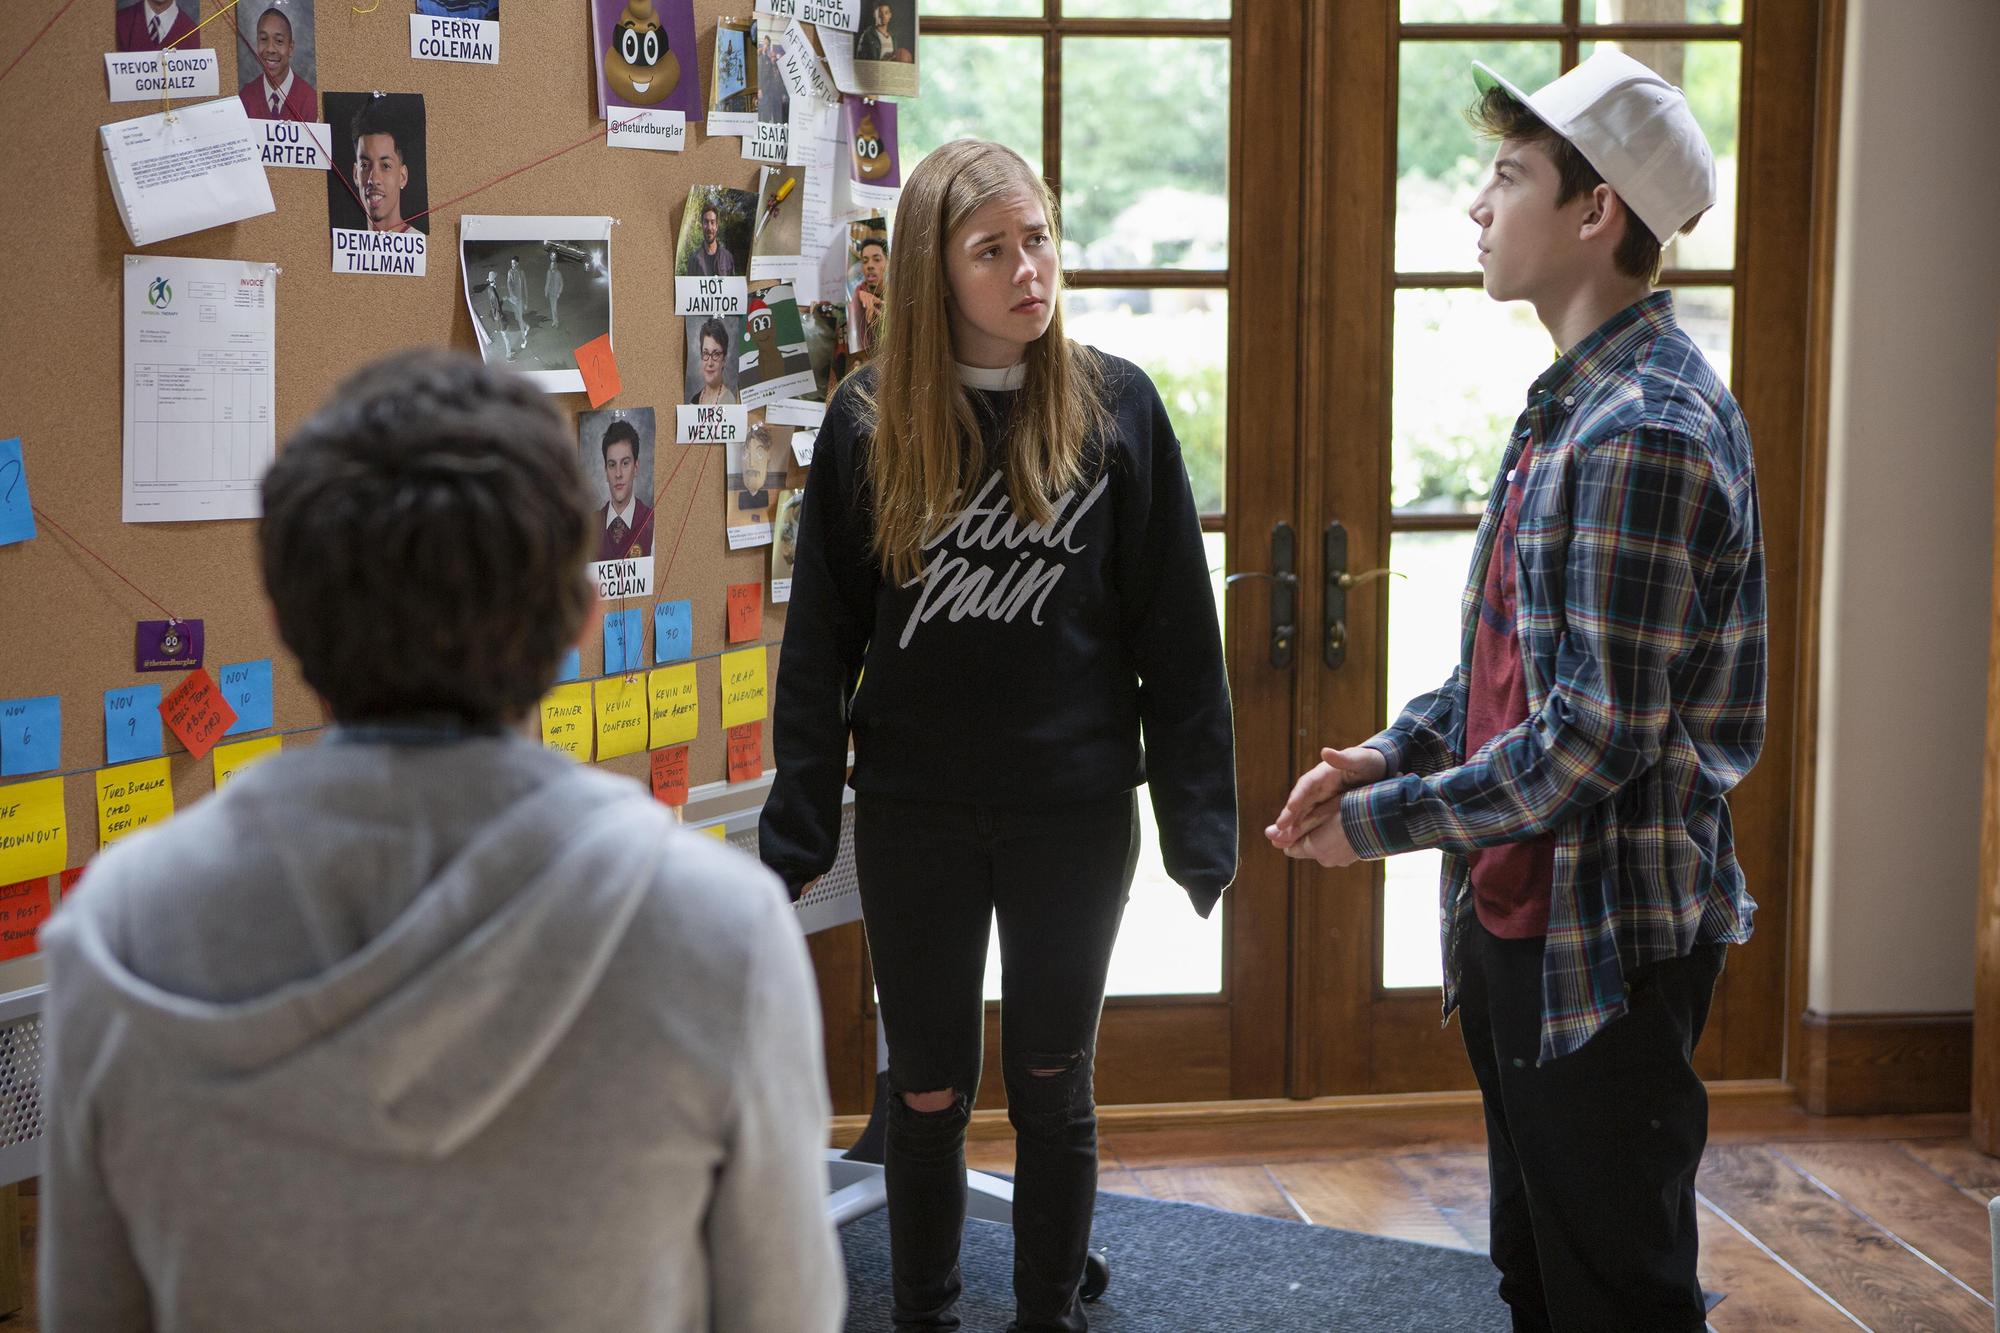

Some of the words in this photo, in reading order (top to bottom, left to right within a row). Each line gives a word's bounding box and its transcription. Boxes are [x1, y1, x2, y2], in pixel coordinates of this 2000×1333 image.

[803, 5, 850, 28] BURTON
[432, 20, 480, 40] PERRY
[420, 38, 492, 60] COLEMAN
[112, 61, 158, 75] TREVOR
[136, 76, 195, 91] GONZALEZ
[266, 123, 299, 143] LOU
[611, 120, 683, 138] @theturdburglar
[758, 125, 789, 143] ISAIA
[257, 144, 316, 165] ARTER
[752, 142, 788, 160] TILLM
[337, 232, 424, 254] DEMARCUS
[346, 253, 415, 273] TILLMAN
[240, 278, 264, 287] INVOICE
[700, 279, 724, 295] HOT
[686, 297, 738, 312] JANITOR
[697, 408, 727, 423] MRS.
[688, 425, 736, 440] WEXLER
[598, 562, 636, 580] KEVIN
[599, 578, 646, 597] CCLAIN
[900, 548, 1067, 649] pain
[657, 605, 675, 616] NOV
[226, 668, 249, 684] NOV
[730, 669, 755, 685] CRAP
[240, 692, 251, 707] 10
[656, 687, 678, 700] KEVIN
[728, 687, 764, 705] CALENDAR
[110, 695, 133, 710] NOV
[605, 698, 632, 714] KEVIN
[671, 703, 697, 718] ARREST
[5, 705, 26, 717] NOV
[187, 698, 210, 734] ABOUT
[547, 705, 582, 719] TANNER
[128, 717, 136, 736] 9
[195, 711, 221, 743] CARD
[566, 723, 575, 732] TO
[602, 718, 641, 733] CONFESSES
[23, 726, 31, 745] 6
[550, 740, 578, 752] POLICE
[103, 783, 125, 800] TURD
[128, 778, 165, 795] BURGLAR
[0, 803, 20, 819] HE
[106, 804, 130, 817] CARD
[108, 820, 132, 833] SEEN
[138, 815, 148, 825] IN
